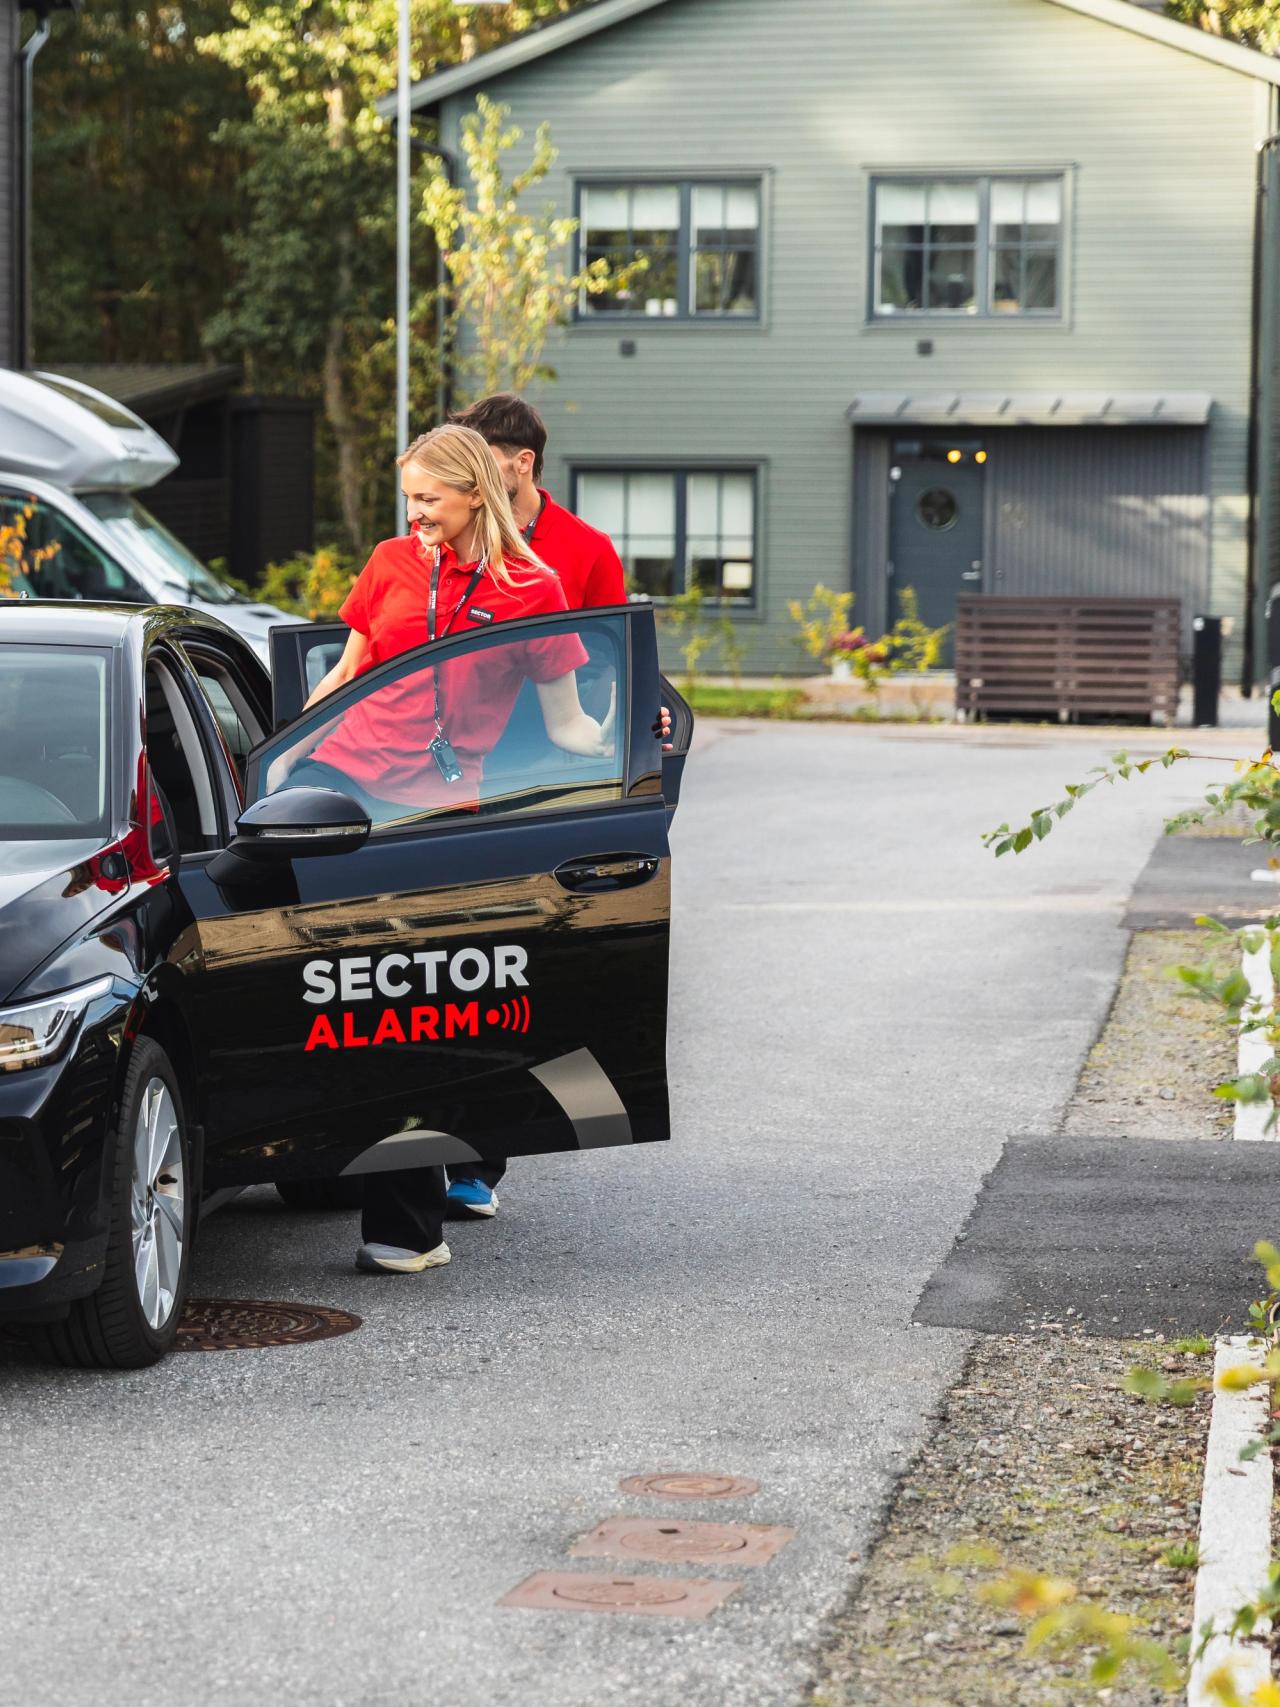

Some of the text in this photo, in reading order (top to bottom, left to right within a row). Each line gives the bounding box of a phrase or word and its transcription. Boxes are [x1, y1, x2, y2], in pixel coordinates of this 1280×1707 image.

[470, 608, 492, 620] SECTOR
[302, 945, 530, 1004] SECTOR
[304, 1001, 480, 1052] ALARM
